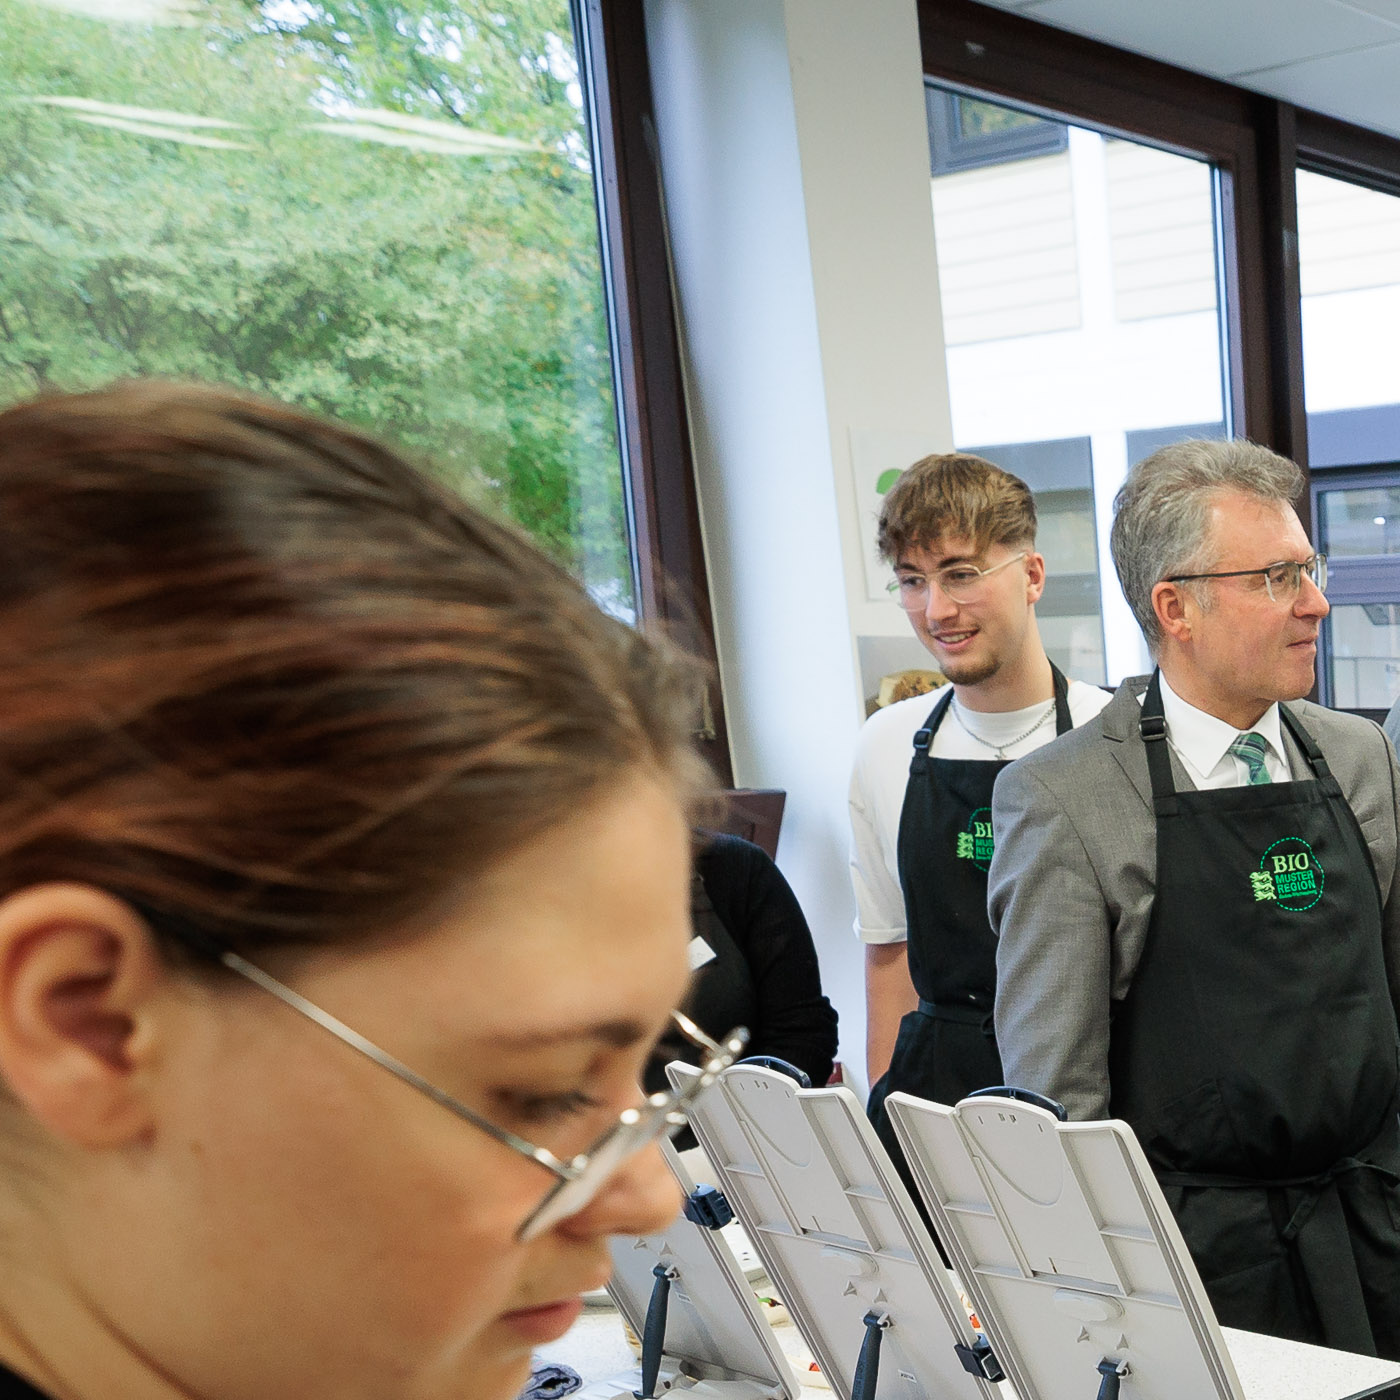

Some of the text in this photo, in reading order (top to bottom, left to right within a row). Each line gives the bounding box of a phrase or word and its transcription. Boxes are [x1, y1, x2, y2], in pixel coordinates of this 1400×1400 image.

[974, 822, 993, 838] BI
[1271, 852, 1309, 874] BIO
[1274, 870, 1314, 884] MUSTER
[1277, 880, 1316, 894] REGION
